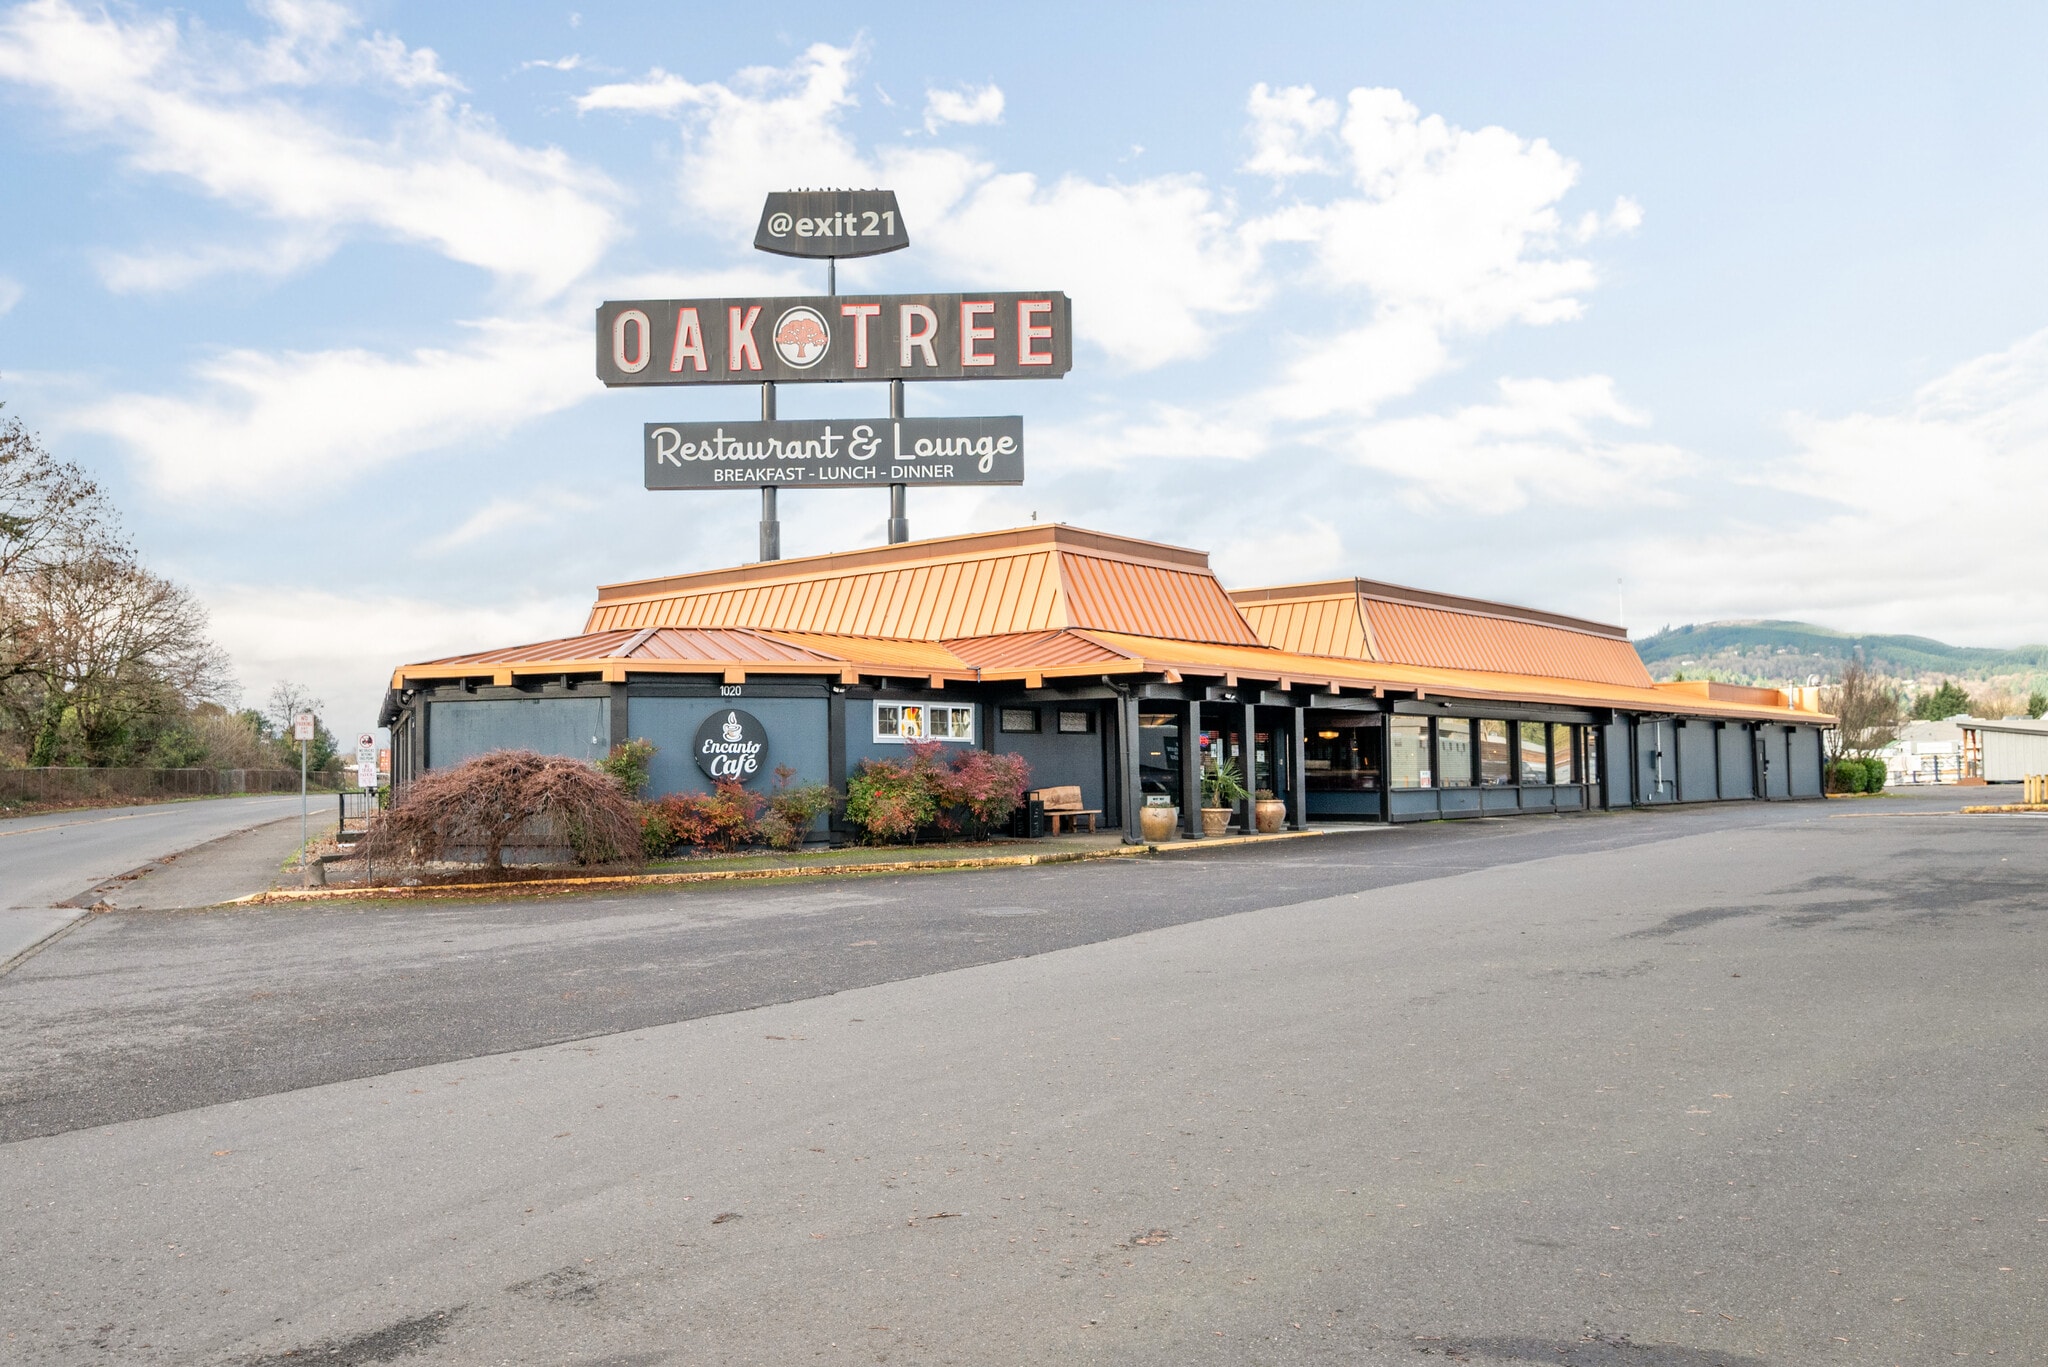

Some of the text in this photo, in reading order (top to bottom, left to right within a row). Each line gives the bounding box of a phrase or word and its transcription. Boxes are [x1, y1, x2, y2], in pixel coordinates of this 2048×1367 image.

[613, 300, 1053, 374] OAK TREE
[651, 422, 1018, 473] Restaurant & Lounge
[714, 467, 806, 482] BREAKFAST
[819, 466, 876, 480] LUNCH
[891, 465, 954, 479] DINNER
[719, 685, 742, 696] 1020
[702, 738, 762, 754] Encanto
[710, 753, 758, 780] Café
